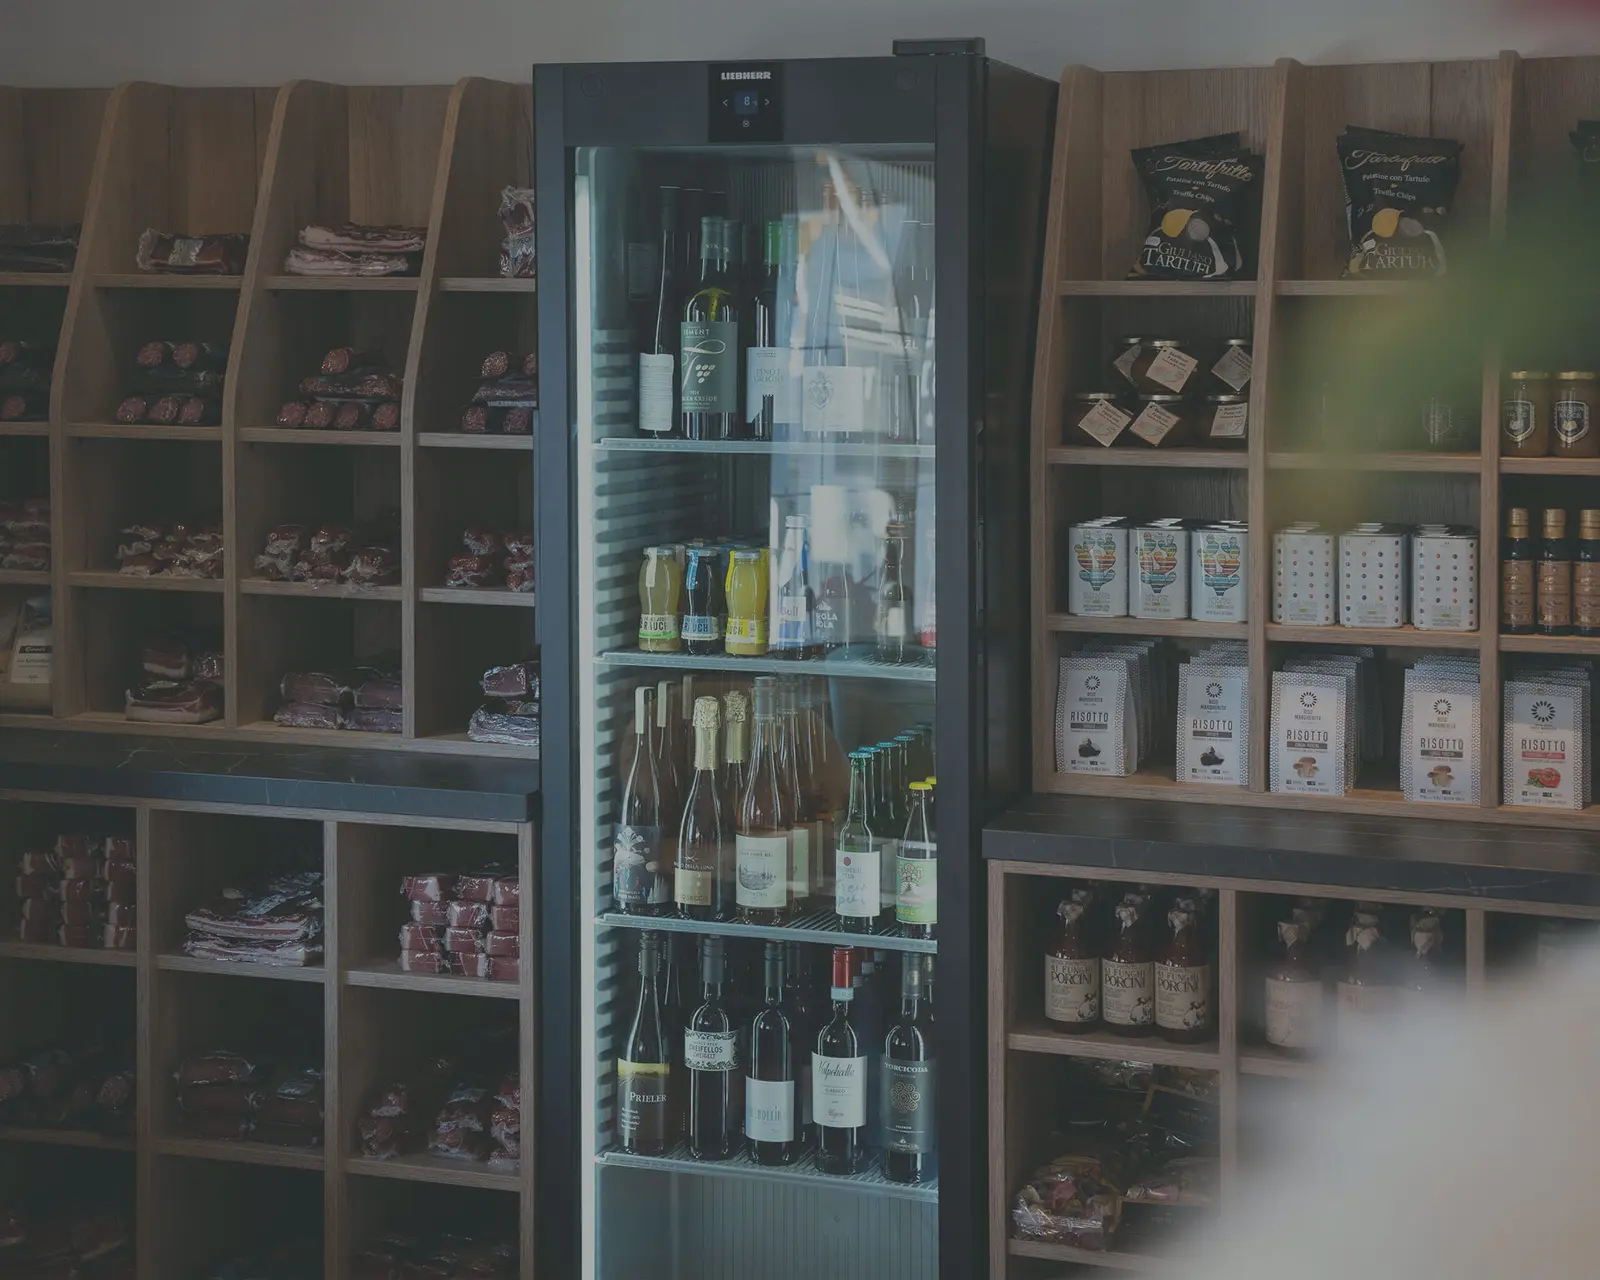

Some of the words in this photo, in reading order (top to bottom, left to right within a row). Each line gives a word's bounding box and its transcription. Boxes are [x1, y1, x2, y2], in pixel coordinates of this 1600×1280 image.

[720, 71, 772, 80] LIEBHERR
[1405, 174, 1430, 183] Tartufo
[1207, 180, 1232, 193] Tartufo
[1397, 191, 1417, 202] Chips
[1070, 711, 1109, 722] RISOTTO
[1192, 719, 1233, 731] RISOTTO
[1286, 729, 1329, 742] RISOTTO
[1420, 737, 1464, 750] RISOTTO
[1521, 739, 1566, 752] RISOTTO
[1051, 971, 1092, 985] PORCINI
[1104, 973, 1146, 989] PORCINI
[1158, 977, 1199, 993] PORCINI
[884, 1061, 929, 1073] TORCICODA
